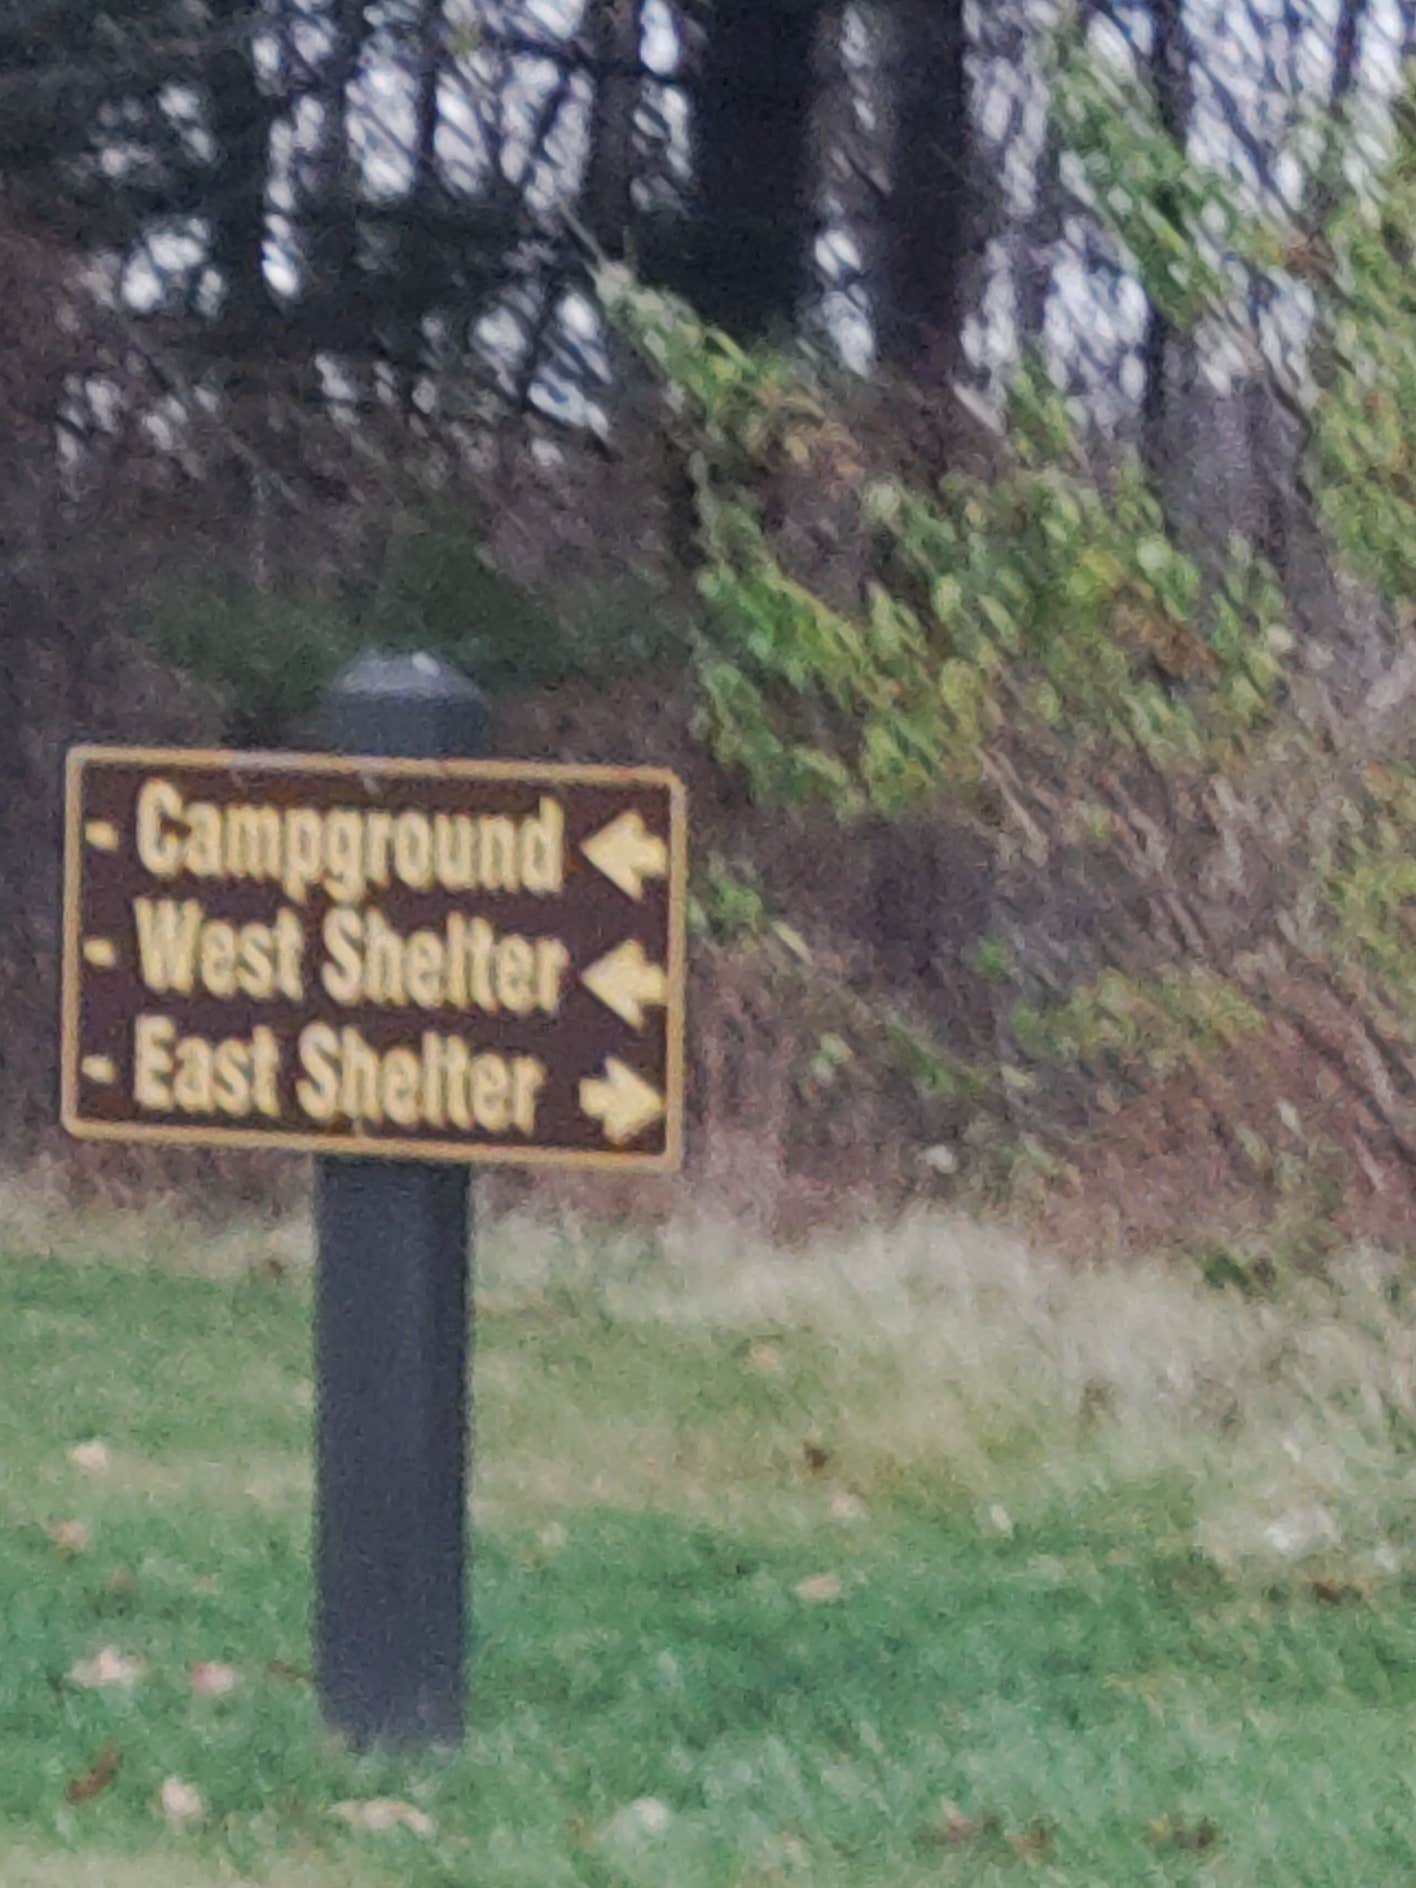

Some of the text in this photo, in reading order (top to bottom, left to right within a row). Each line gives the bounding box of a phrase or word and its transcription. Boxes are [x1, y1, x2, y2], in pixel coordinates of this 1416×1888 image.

[135, 778, 564, 904] Campground
[133, 897, 569, 1013] West Shelter
[133, 1014, 544, 1134] East Shelter
